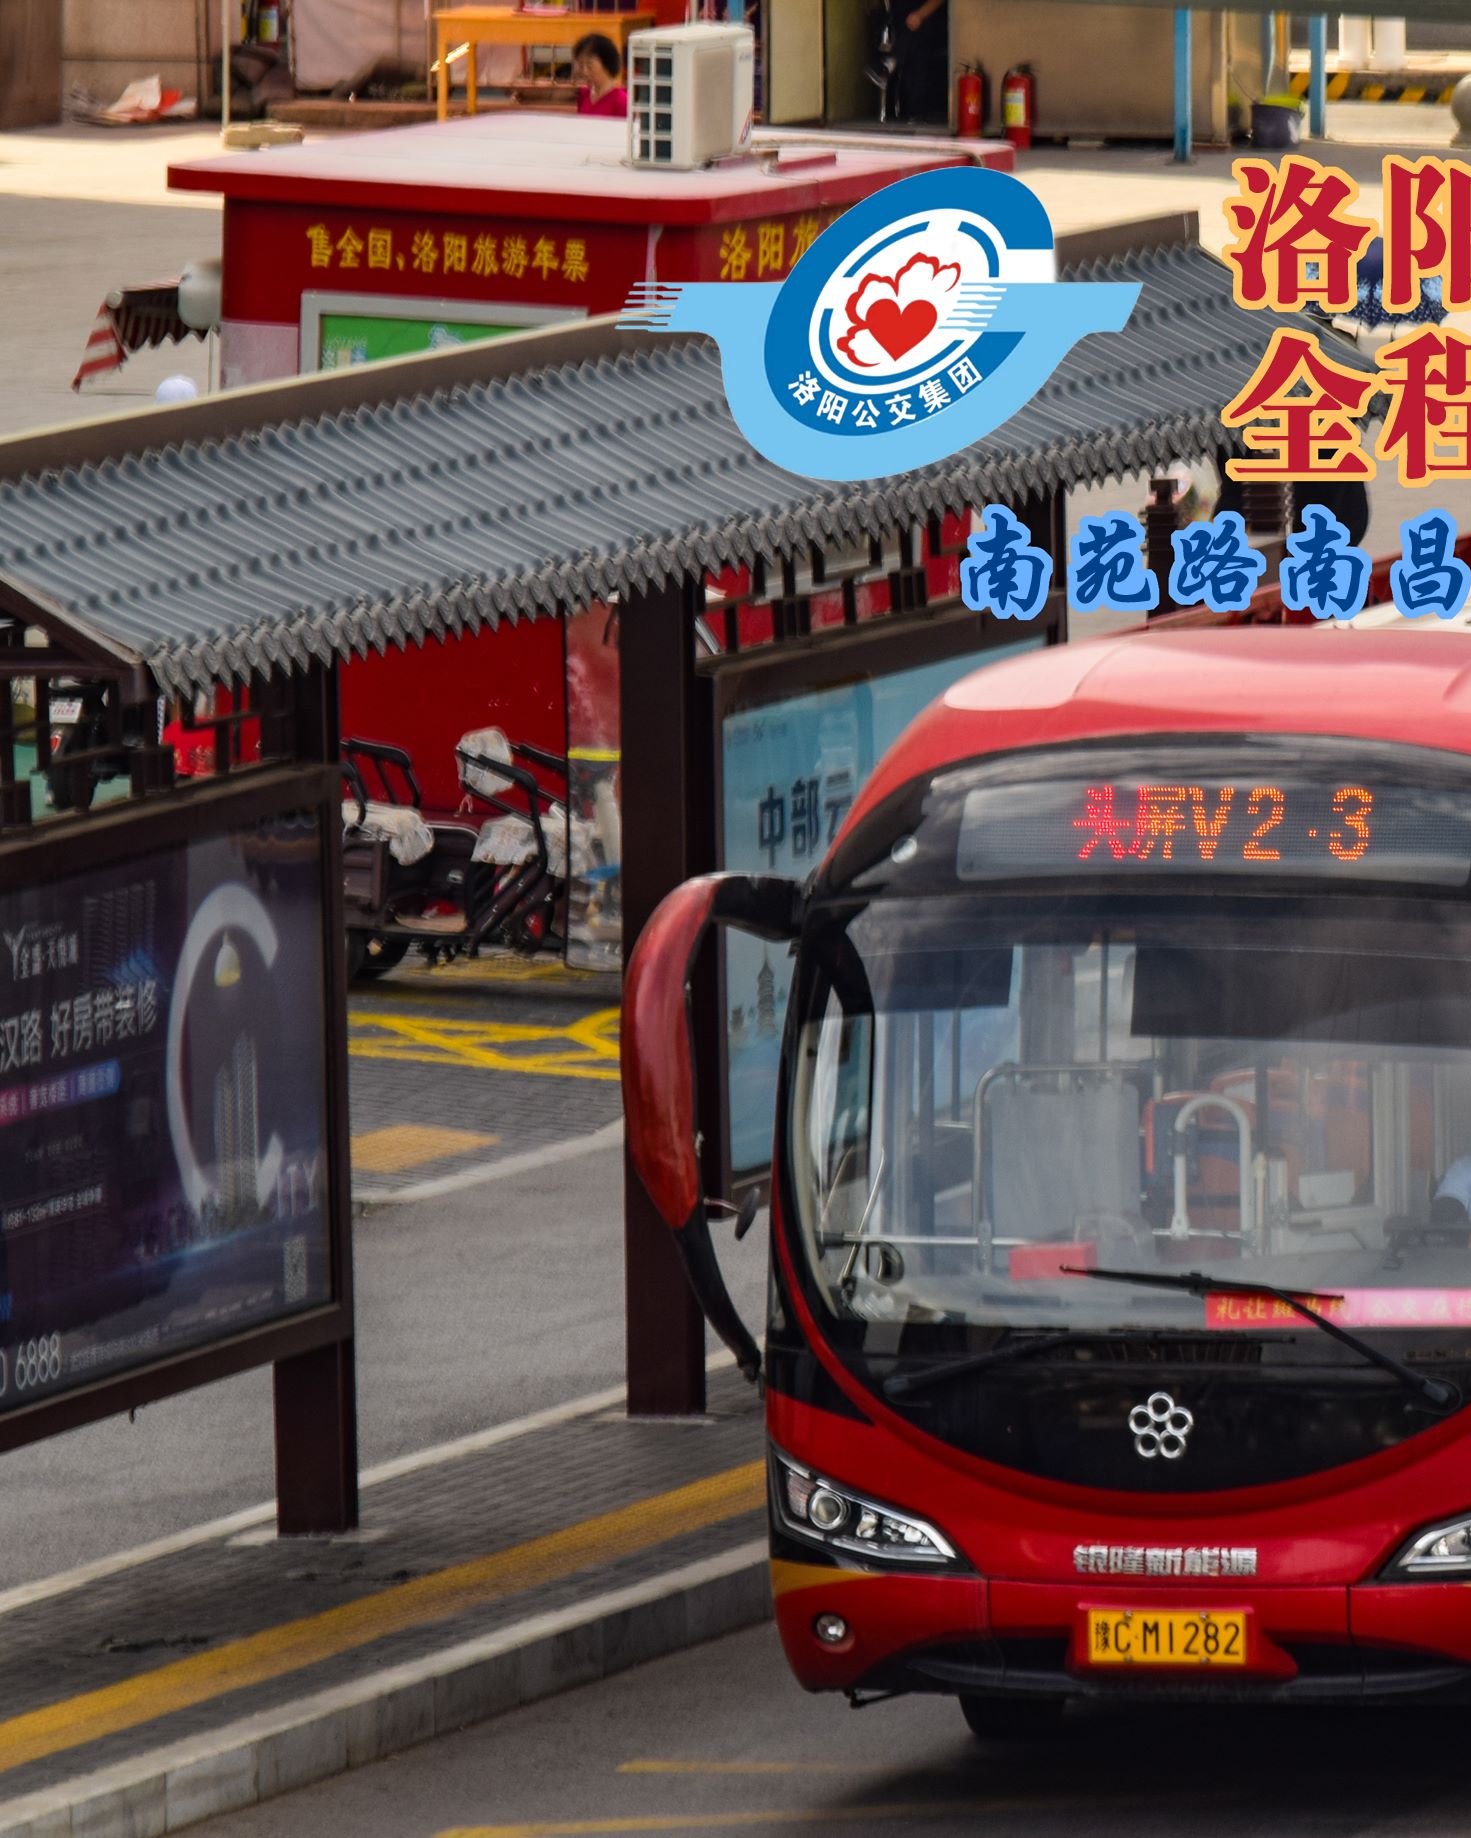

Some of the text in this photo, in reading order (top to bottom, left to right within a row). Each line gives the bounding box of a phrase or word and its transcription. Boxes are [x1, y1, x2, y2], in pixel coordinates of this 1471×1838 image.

[306, 223, 590, 283] 售全国、洛阳旅游年票
[719, 213, 842, 281] 洛阳旅
[15, 1329, 63, 1390] 6888
[1073, 1545, 1258, 1577] 银隆新能源
